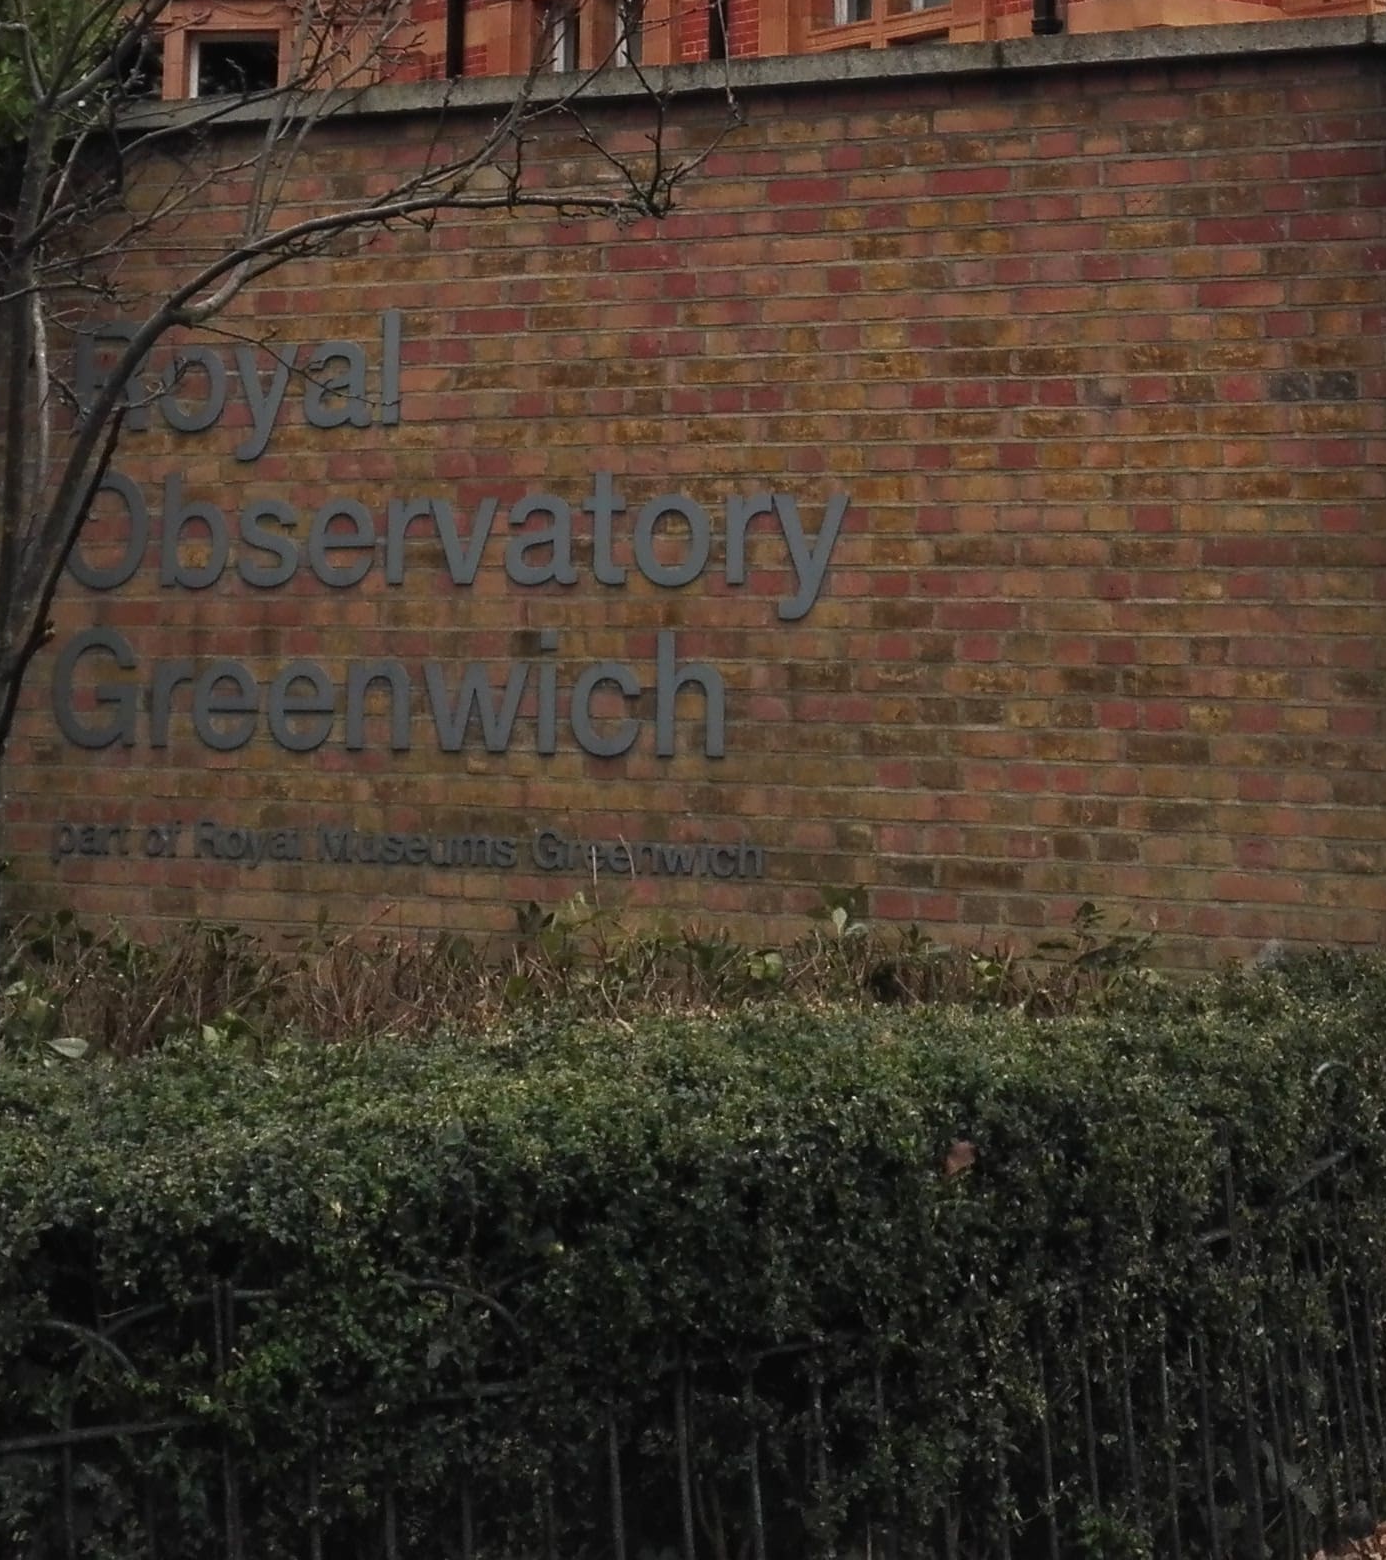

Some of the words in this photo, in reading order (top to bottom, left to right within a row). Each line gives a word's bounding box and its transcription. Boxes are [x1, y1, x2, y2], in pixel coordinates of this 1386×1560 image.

[75, 309, 402, 463] Royal
[63, 469, 851, 622] Observatory
[51, 625, 726, 759] Greenwich
[52, 820, 130, 865] part
[144, 819, 183, 859] of
[193, 820, 303, 871] Royal
[316, 823, 516, 868] Museums
[532, 827, 765, 879] Greenwich
